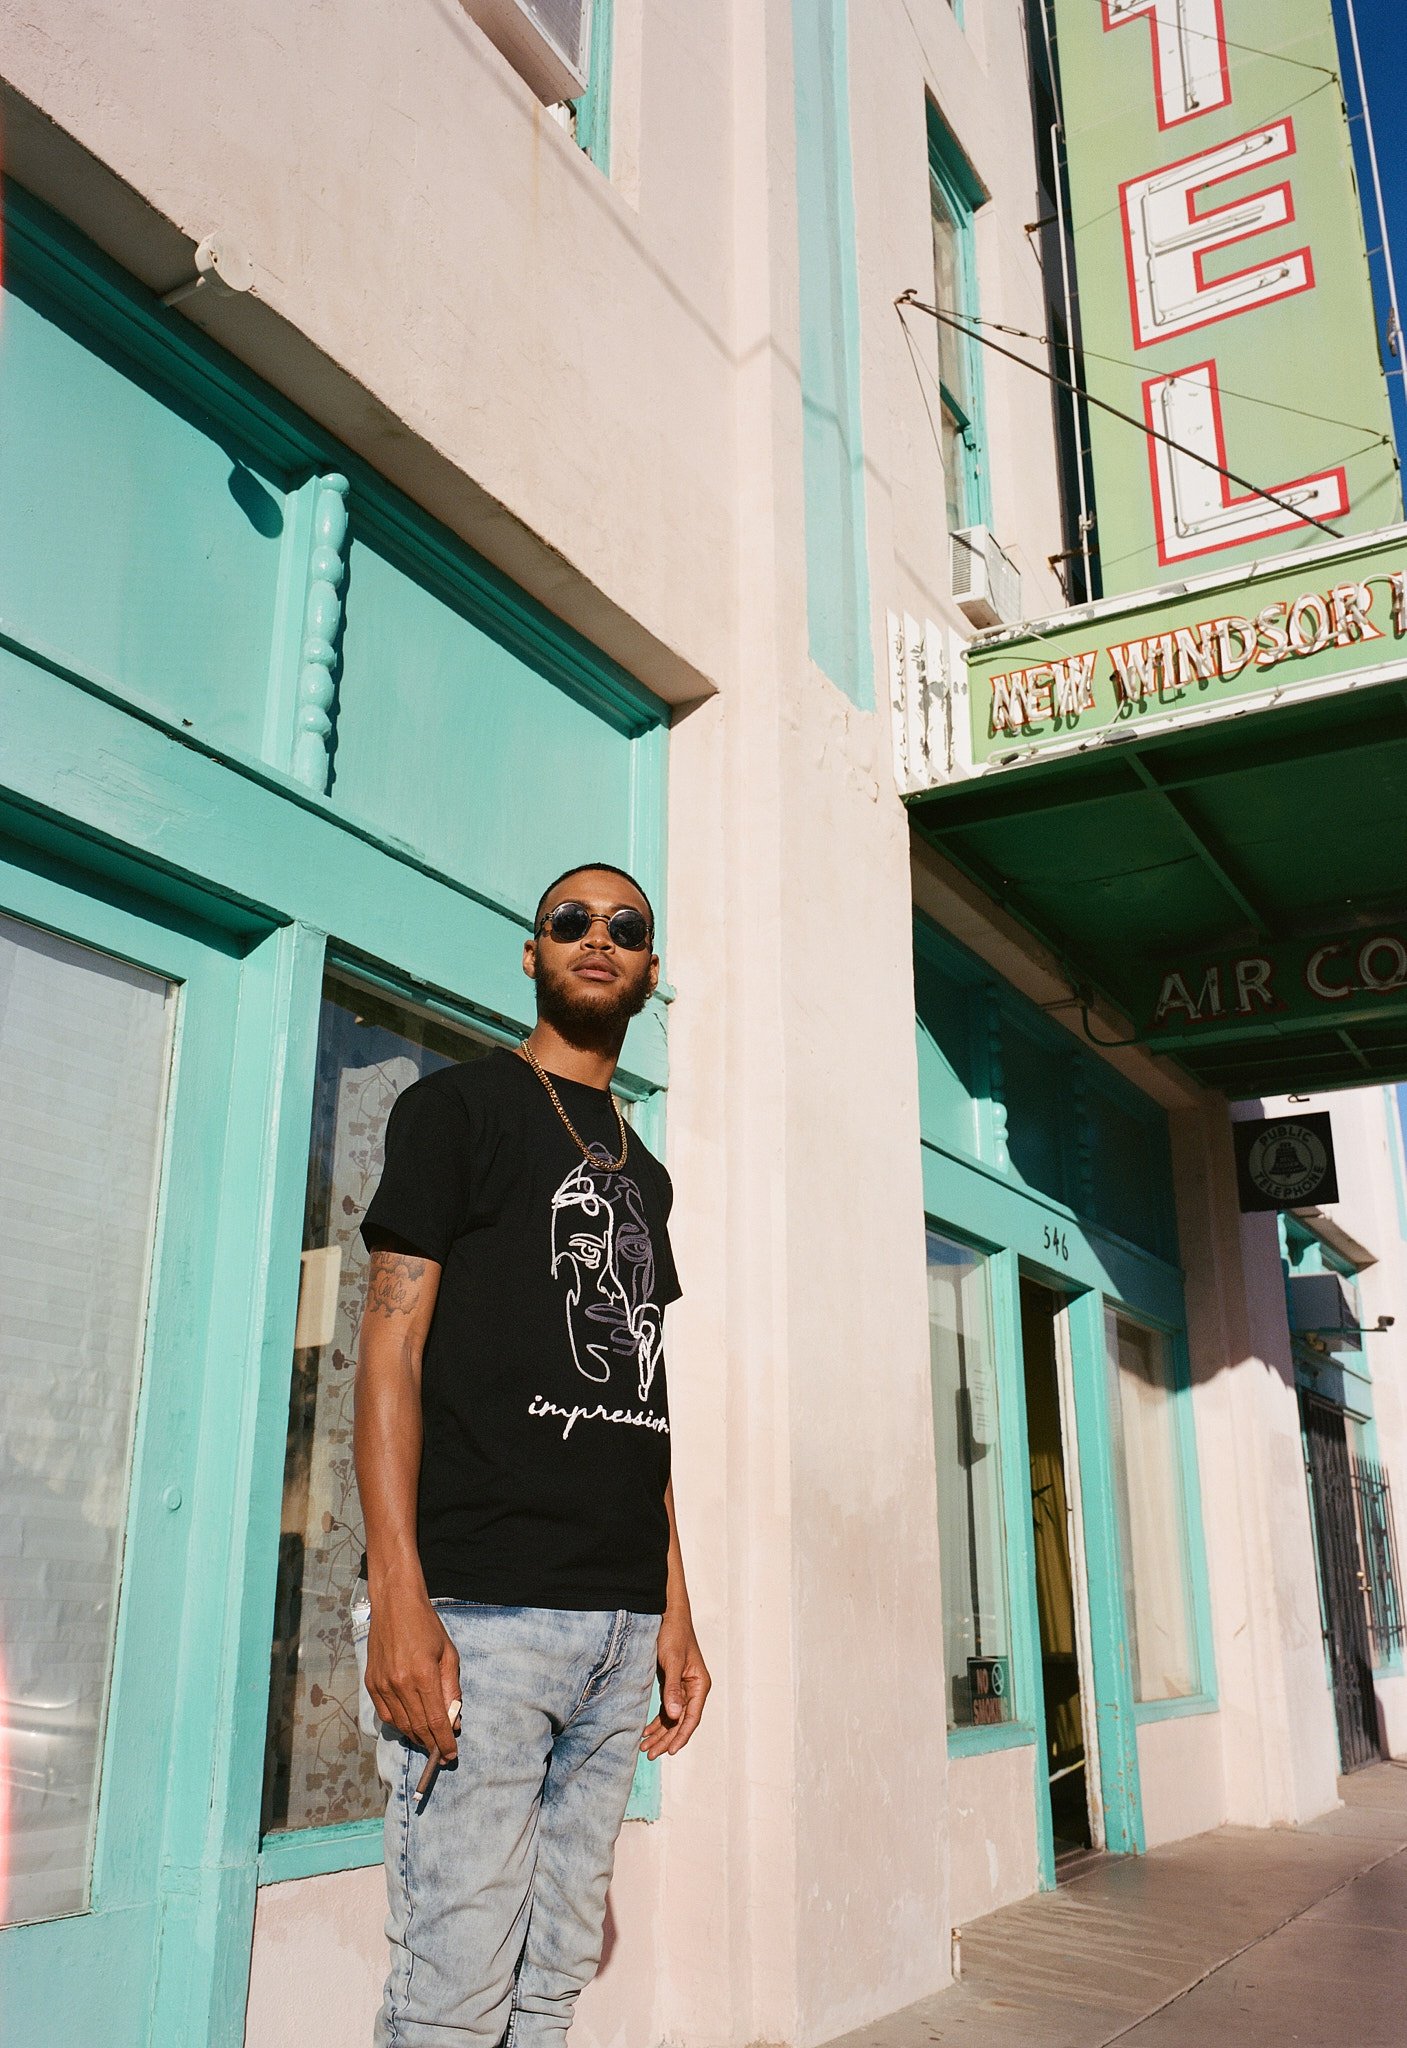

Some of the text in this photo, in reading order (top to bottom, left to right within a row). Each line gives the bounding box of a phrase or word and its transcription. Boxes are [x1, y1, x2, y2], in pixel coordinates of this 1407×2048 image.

[989, 650, 1098, 733] NEW
[1106, 581, 1385, 699] WINDSOR
[1151, 957, 1282, 1026] AIR
[1259, 1126, 1312, 1146] PUBLIC
[1254, 1166, 1325, 1198] TELEPHONE
[1044, 1224, 1069, 1262] 546
[976, 1667, 989, 1694] NO
